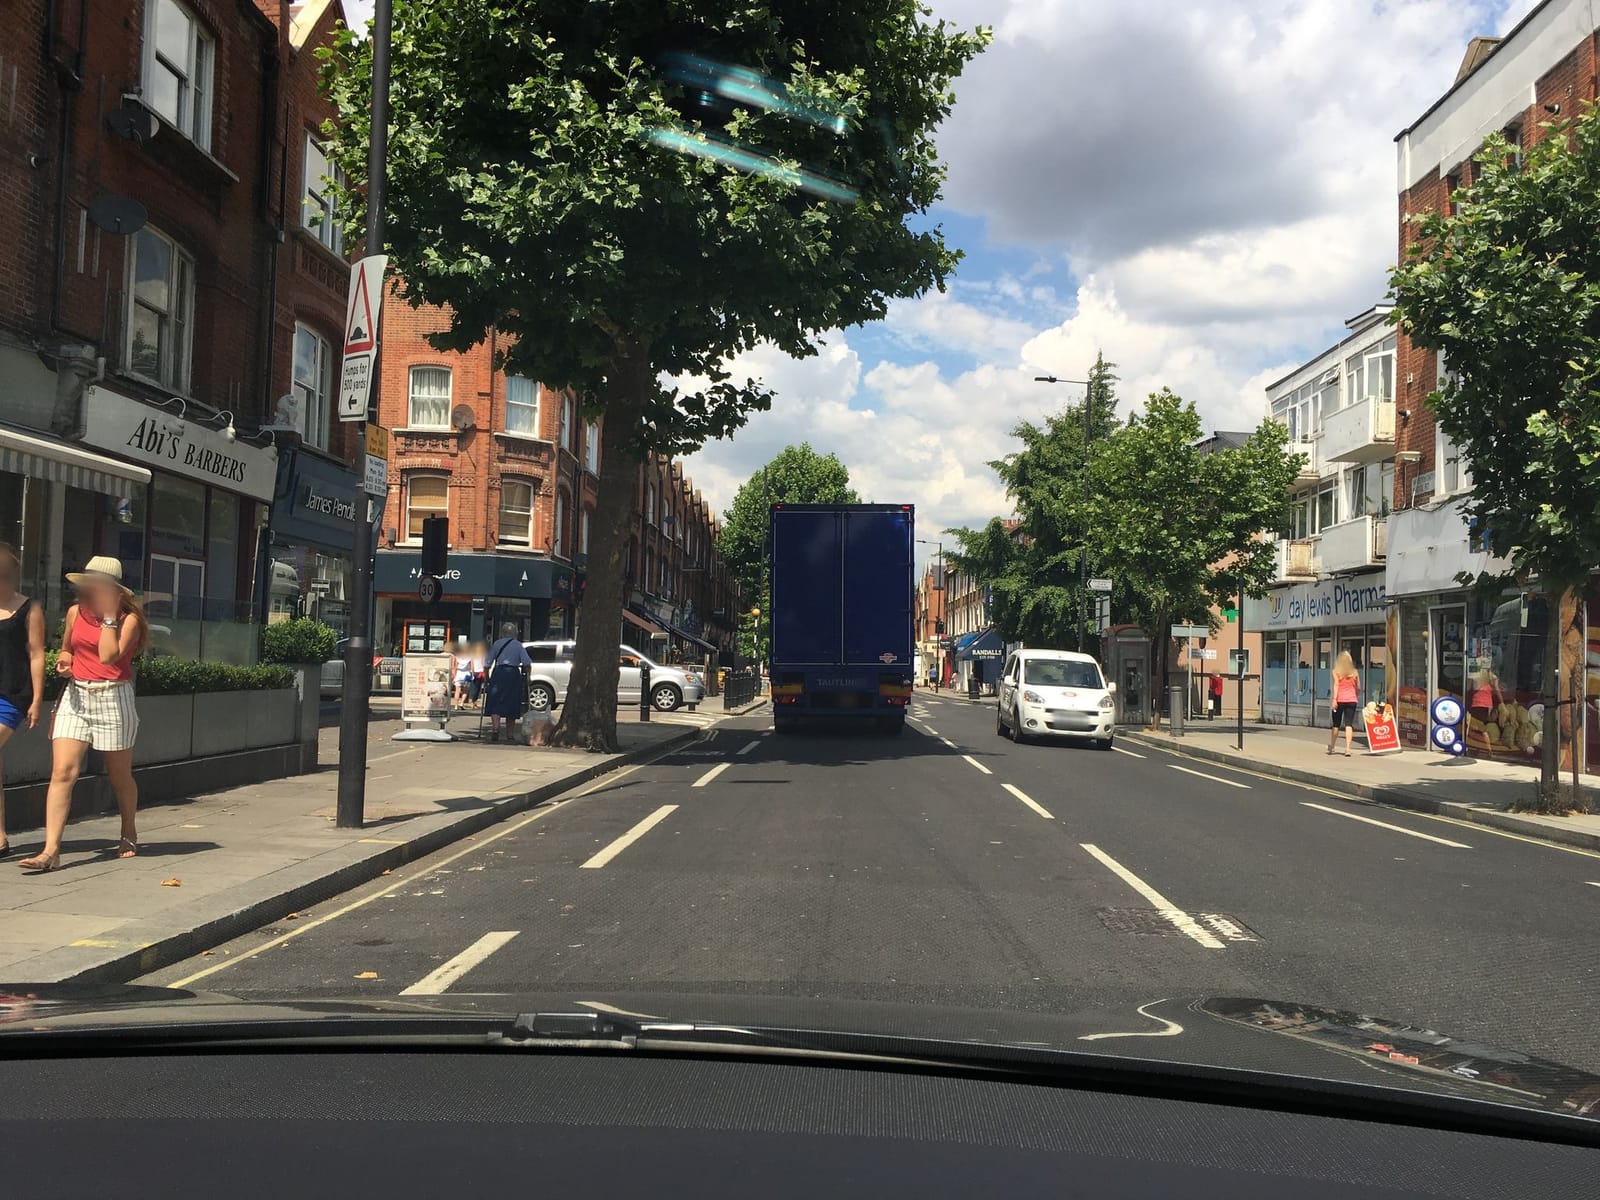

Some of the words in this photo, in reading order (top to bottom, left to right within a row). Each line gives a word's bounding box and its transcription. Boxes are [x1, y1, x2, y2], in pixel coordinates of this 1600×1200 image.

[353, 378, 366, 392] yards
[126, 417, 180, 460] Abi's
[184, 443, 247, 482] BARBERS
[305, 487, 332, 514] James
[421, 584, 433, 596] 30
[1289, 595, 1305, 624] day
[1307, 592, 1331, 618] lewis
